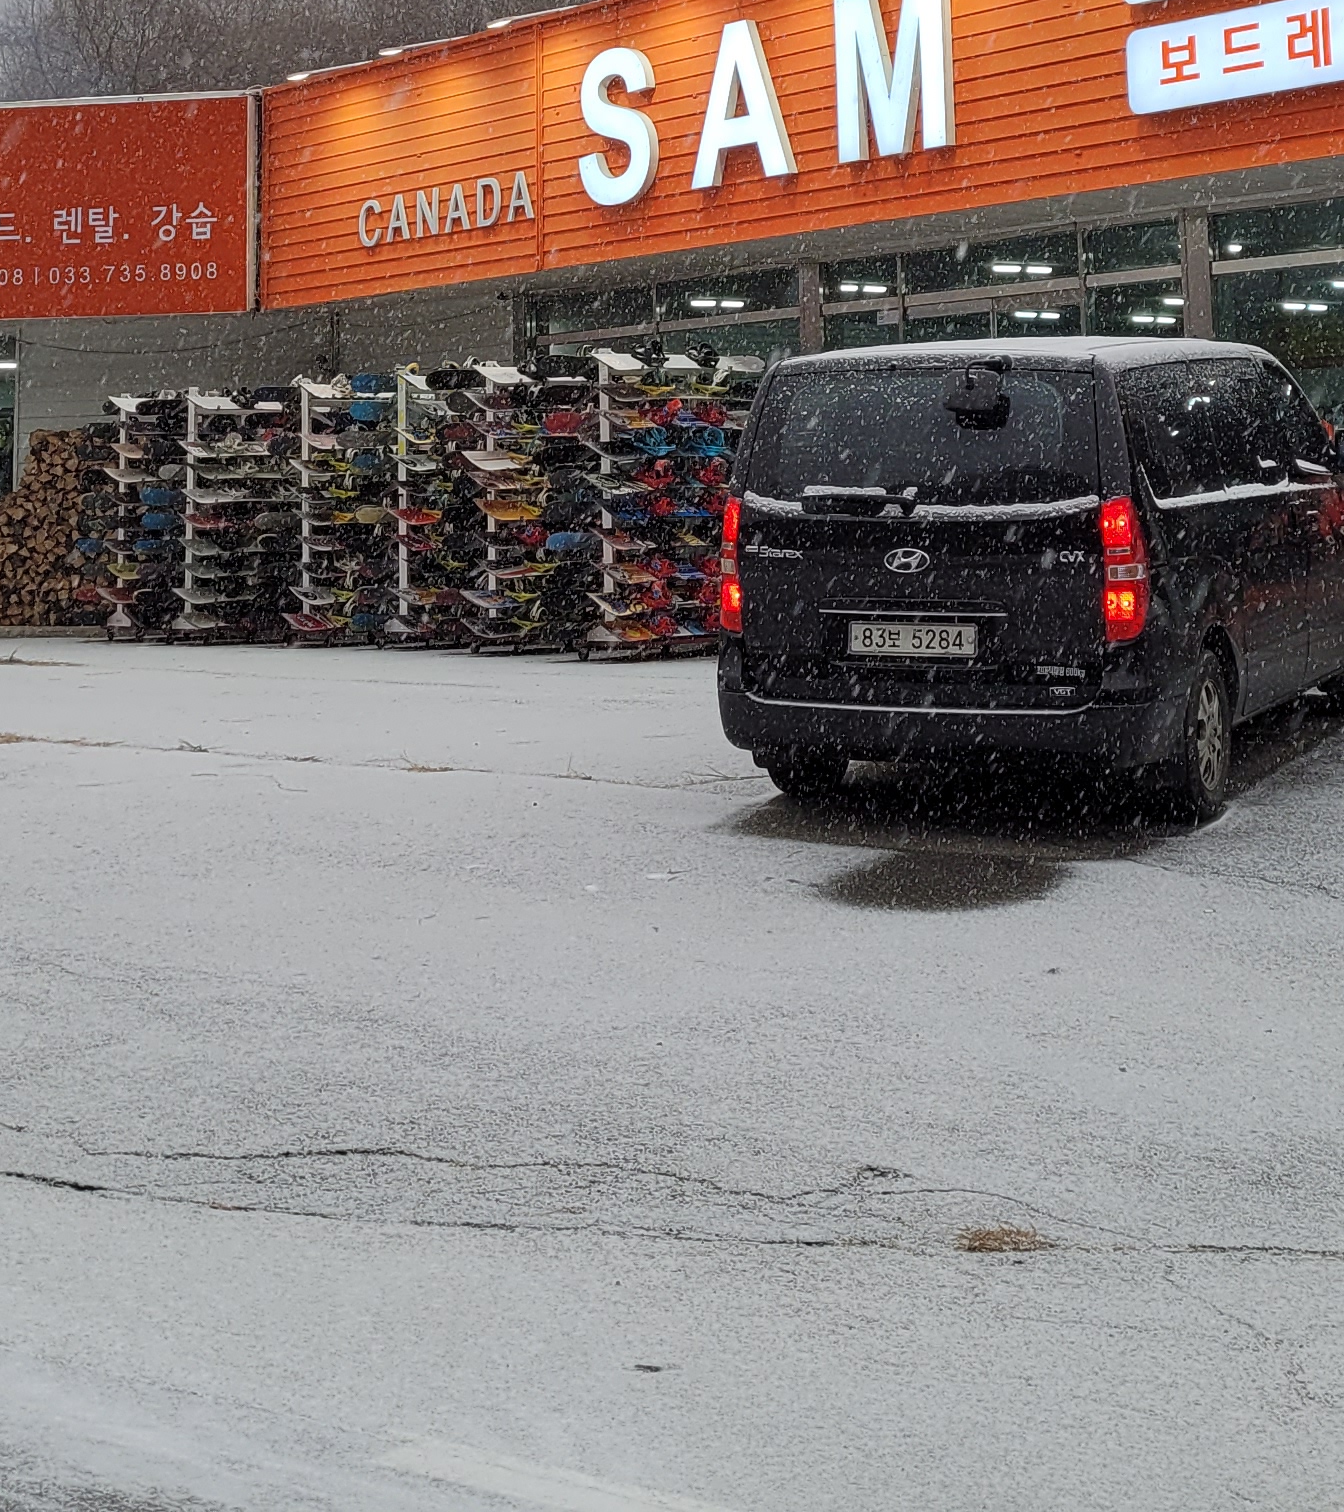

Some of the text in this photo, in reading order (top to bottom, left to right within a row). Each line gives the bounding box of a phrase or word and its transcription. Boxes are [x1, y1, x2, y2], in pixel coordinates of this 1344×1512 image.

[53, 205, 130, 245] 렌탈.
[151, 201, 219, 243] 강습
[358, 170, 535, 248] CANADA
[862, 627, 965, 651] 83보 5284
